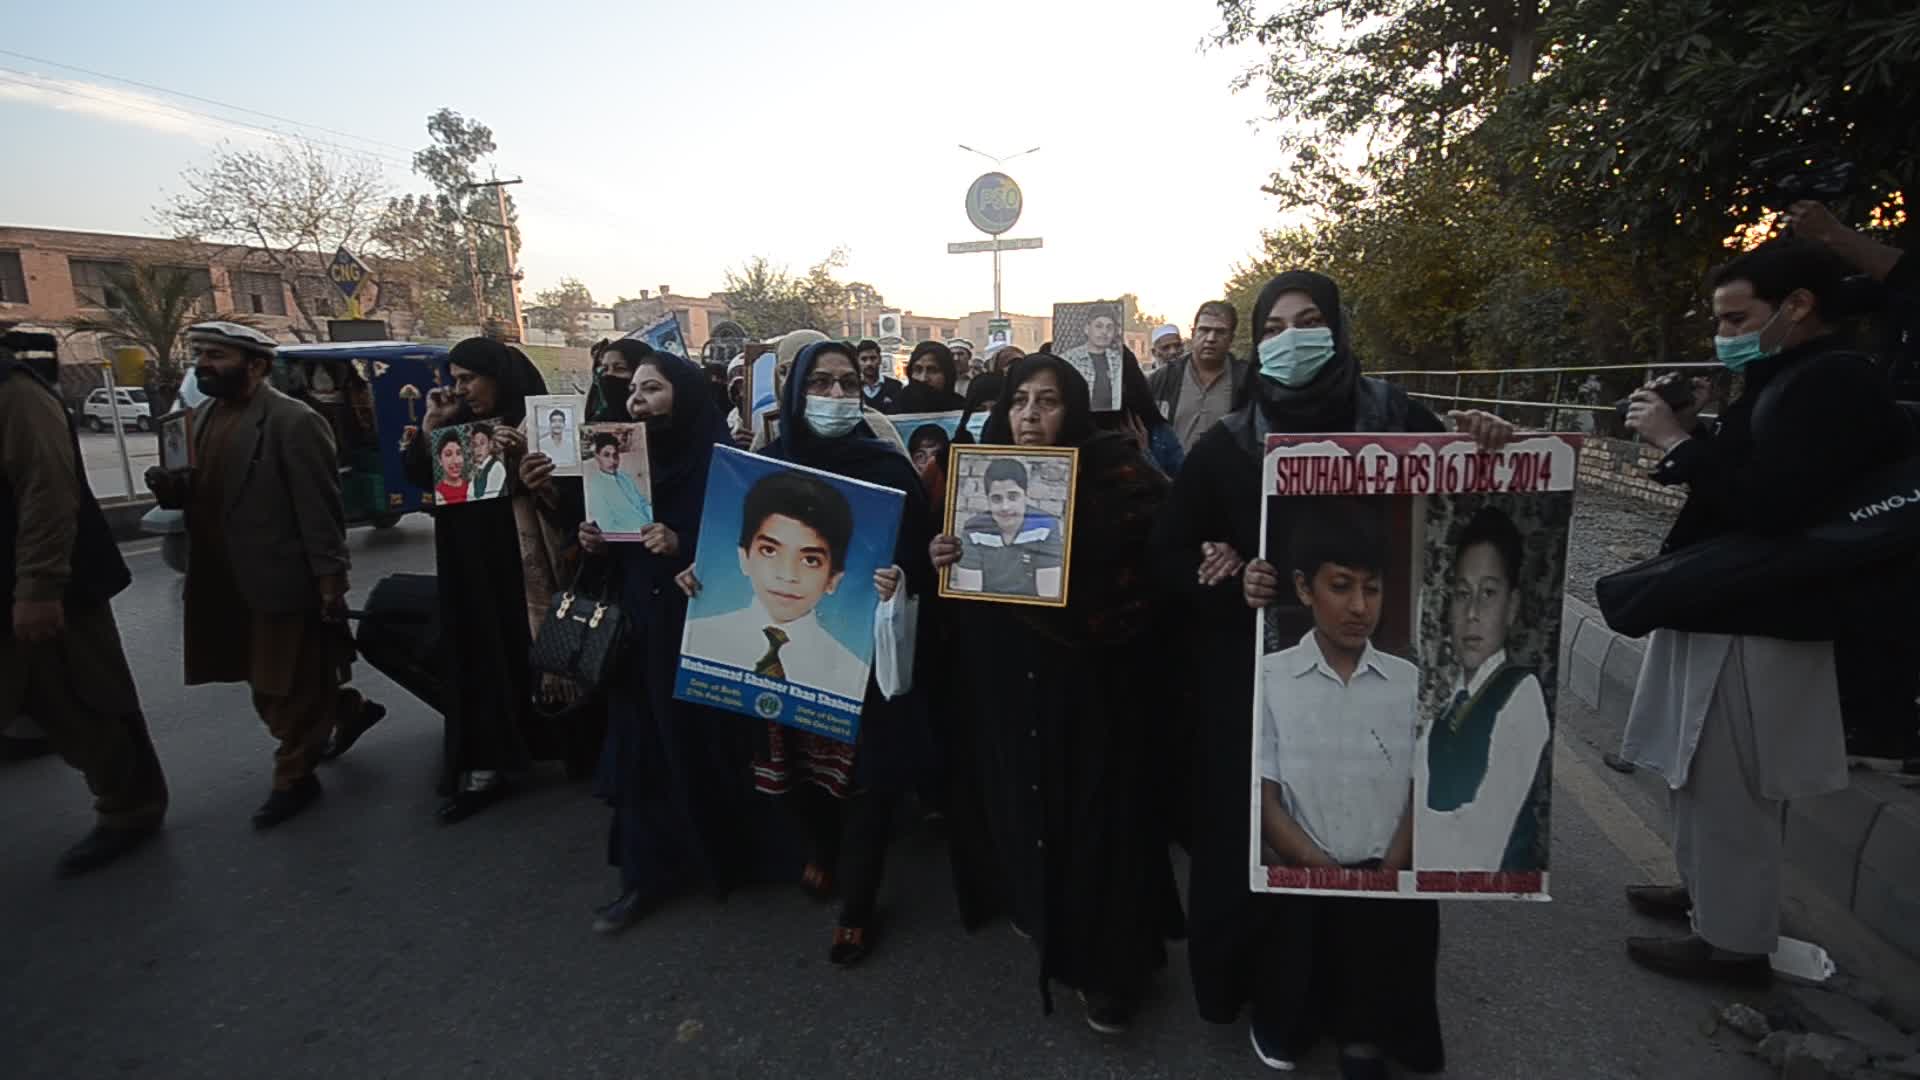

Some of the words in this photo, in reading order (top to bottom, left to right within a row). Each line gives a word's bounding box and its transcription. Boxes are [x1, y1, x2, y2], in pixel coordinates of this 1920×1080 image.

[331, 263, 361, 282] CNG
[1436, 452, 1458, 493] 16
[1464, 451, 1505, 492] DEC
[1509, 452, 1552, 492] 2014
